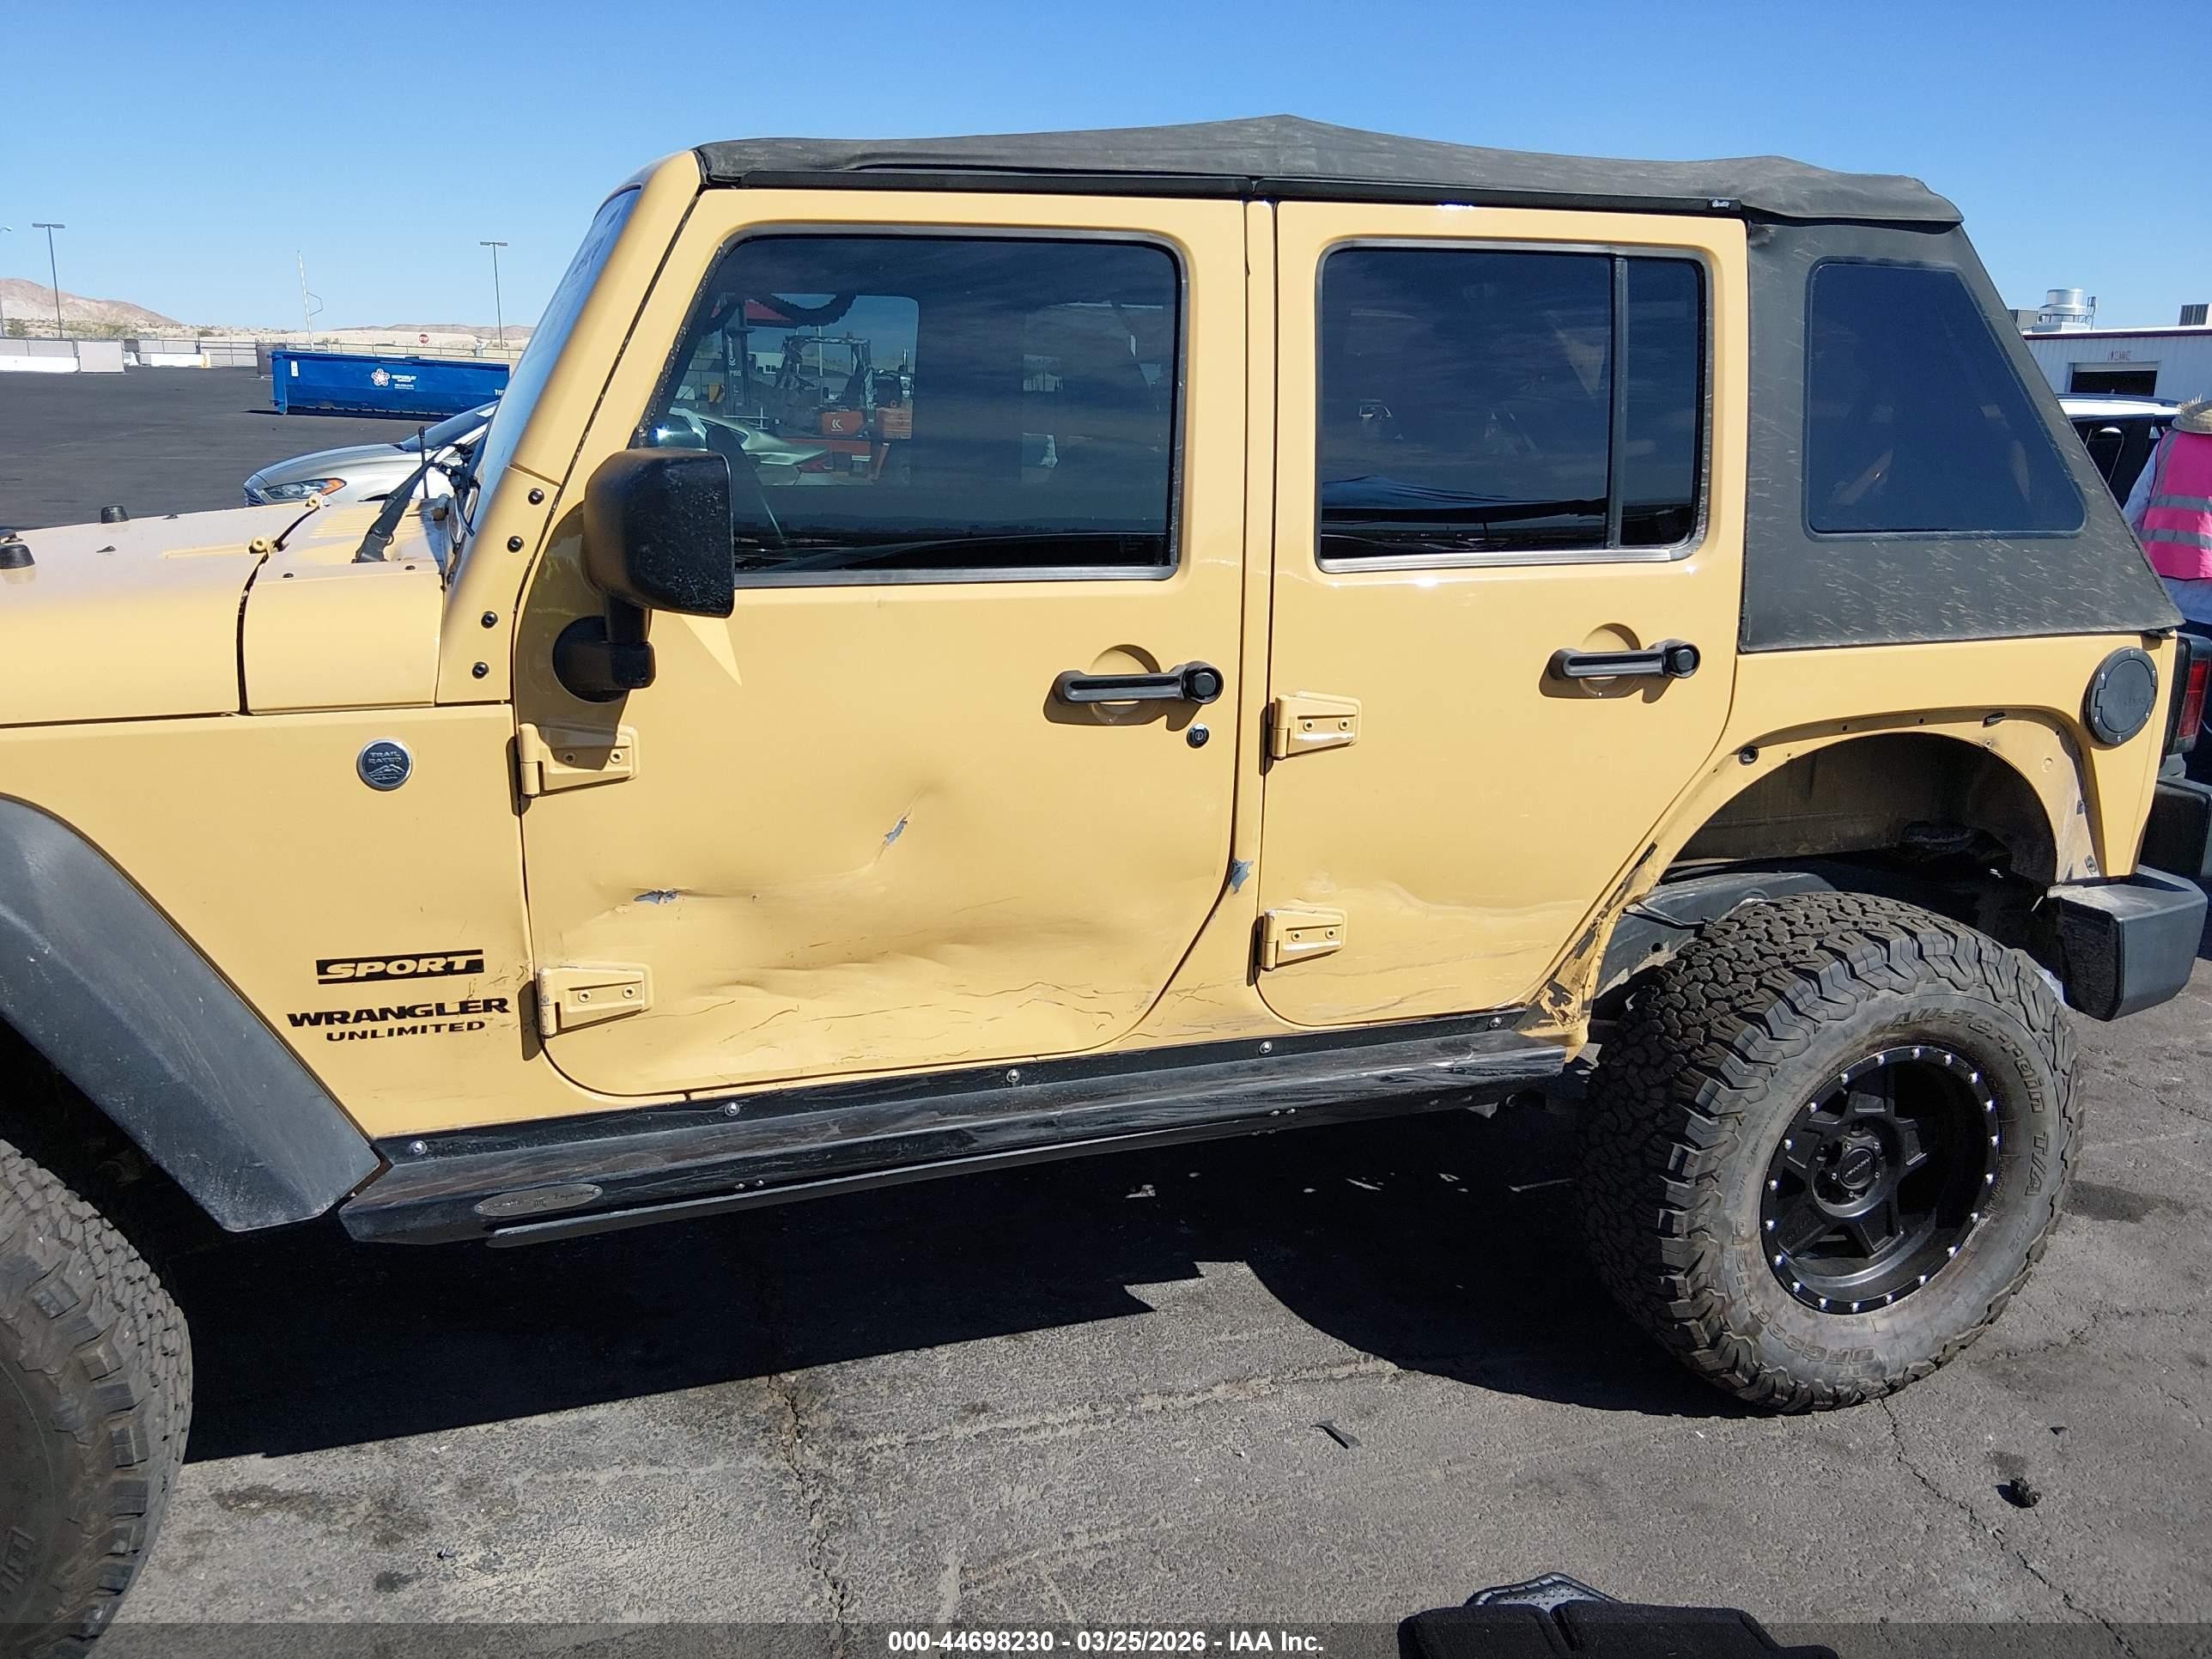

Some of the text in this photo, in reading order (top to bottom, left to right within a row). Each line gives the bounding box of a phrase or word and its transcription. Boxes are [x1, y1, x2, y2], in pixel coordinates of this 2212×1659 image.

[317, 951, 484, 983] SPORT
[287, 997, 511, 1027] WRANGLER
[326, 1020, 486, 1042] UNLIMITED
